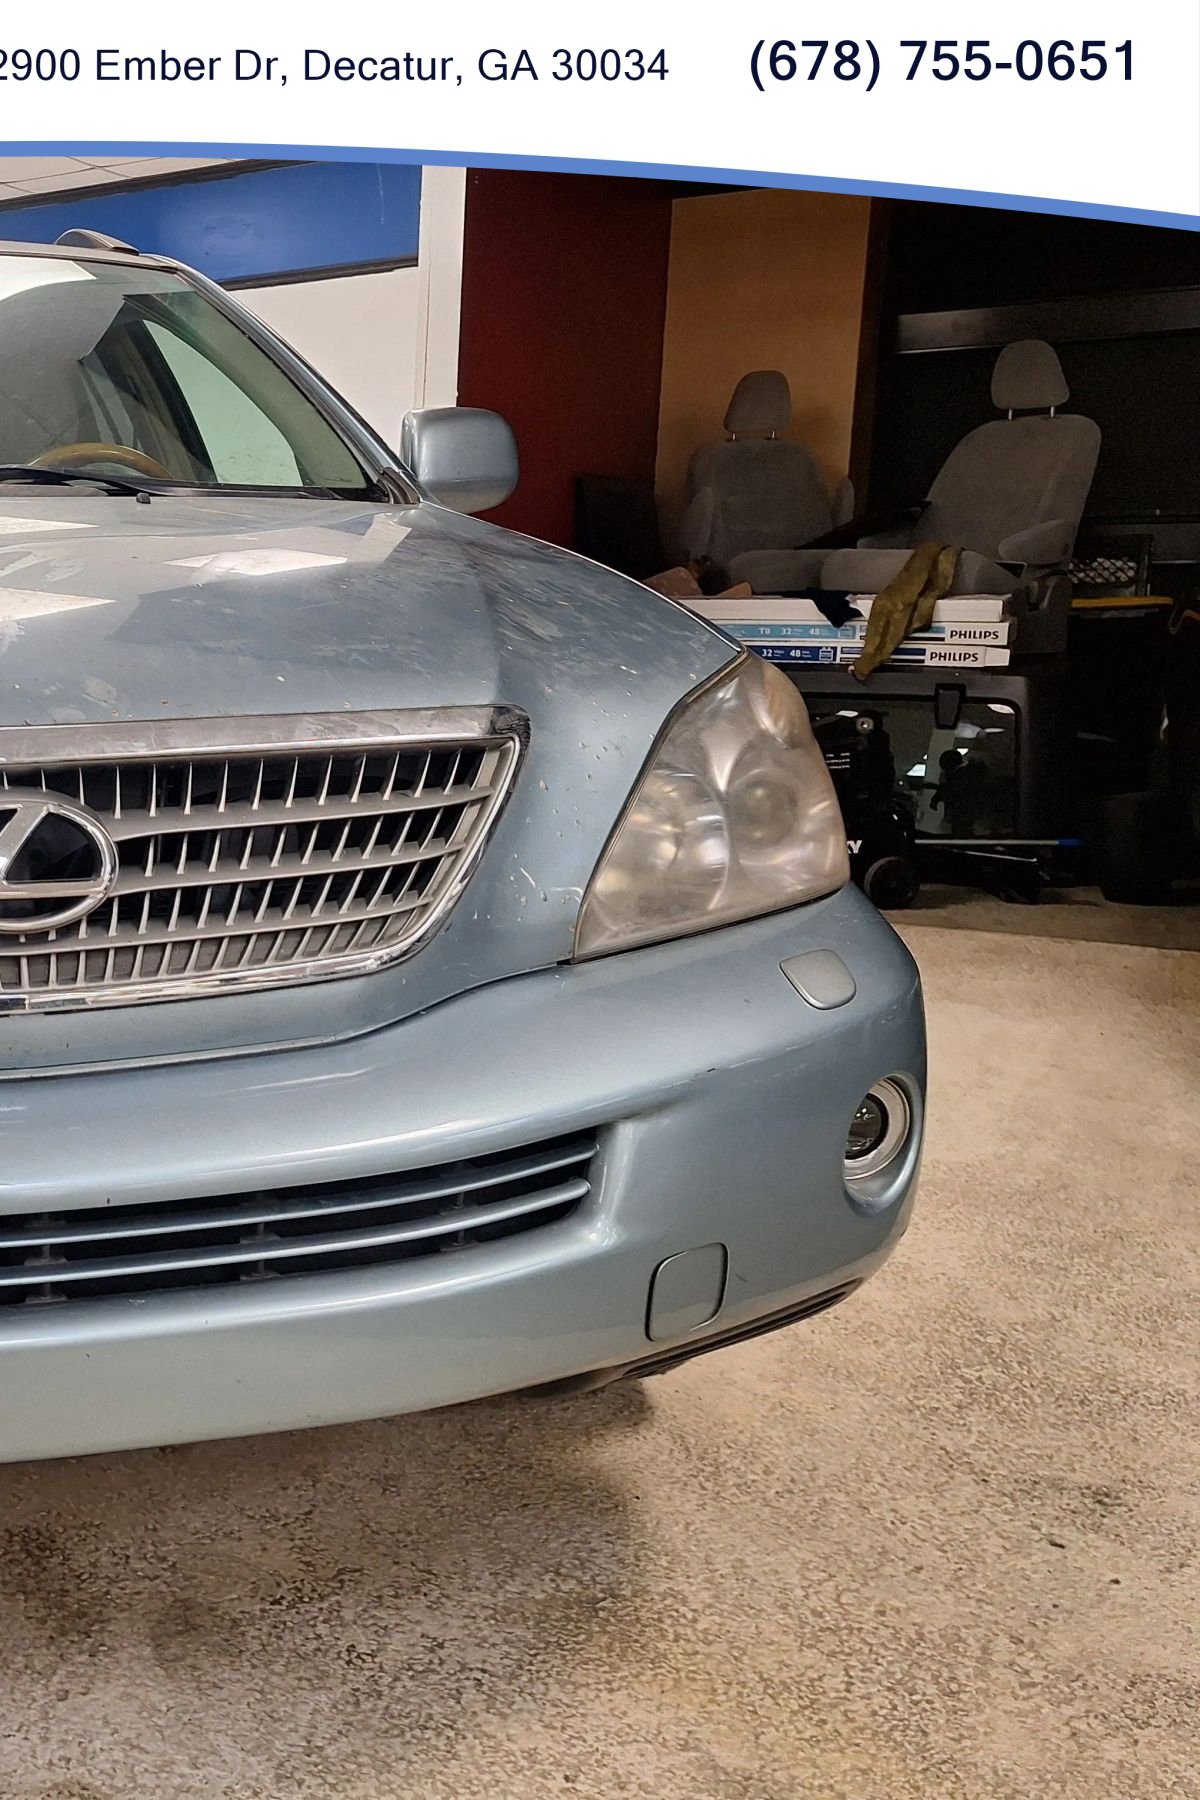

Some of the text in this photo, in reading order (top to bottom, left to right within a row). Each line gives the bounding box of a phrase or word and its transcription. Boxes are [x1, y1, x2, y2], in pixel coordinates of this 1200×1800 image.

[781, 627, 792, 635] 32
[949, 630, 1000, 641] PHILIPS
[761, 649, 773, 657] 32
[789, 649, 801, 657] 48
[929, 651, 979, 662] PHILIPS
